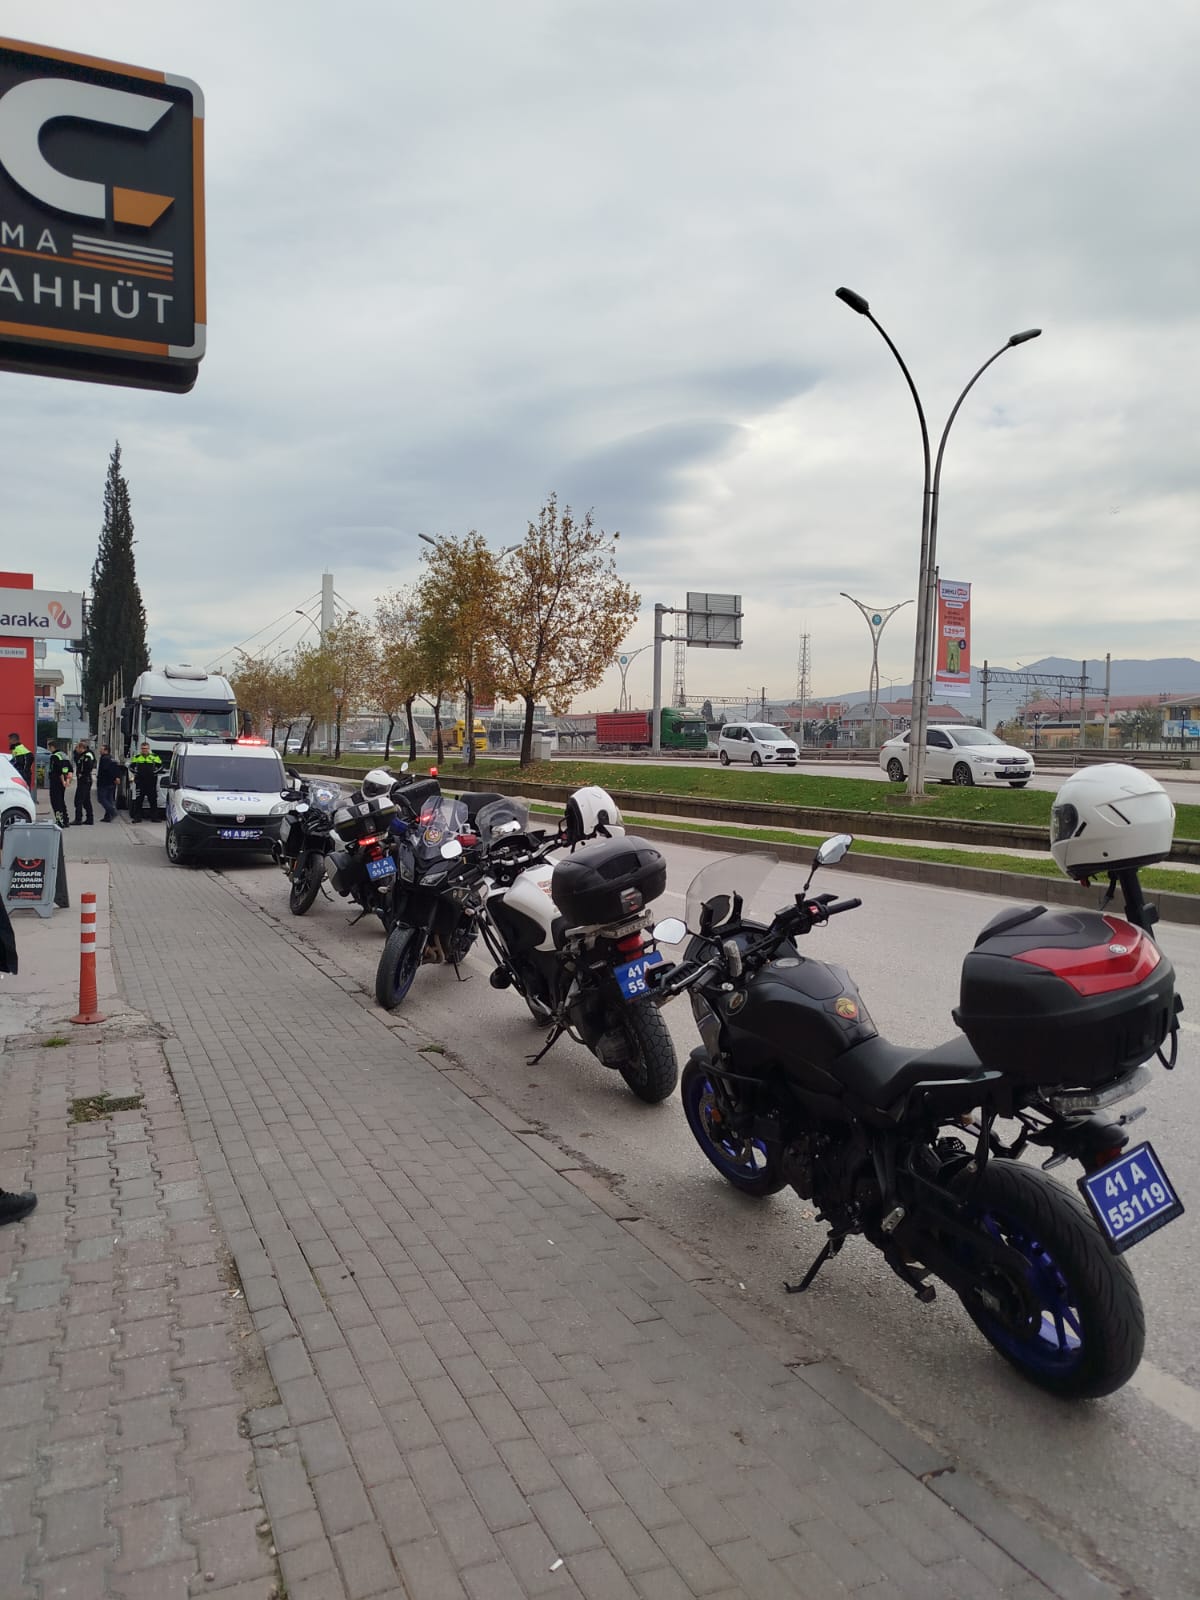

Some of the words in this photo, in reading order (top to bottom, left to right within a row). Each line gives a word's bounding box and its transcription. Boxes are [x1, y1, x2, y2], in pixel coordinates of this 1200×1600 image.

[1, 221, 58, 254] MA
[0, 267, 174, 324] AHHÜT
[0, 612, 49, 628] araka
[223, 830, 232, 838] 41
[628, 965, 642, 978] 41
[1106, 1171, 1128, 1197] 41
[1130, 1162, 1147, 1185] A
[1107, 1182, 1165, 1229] 55119
